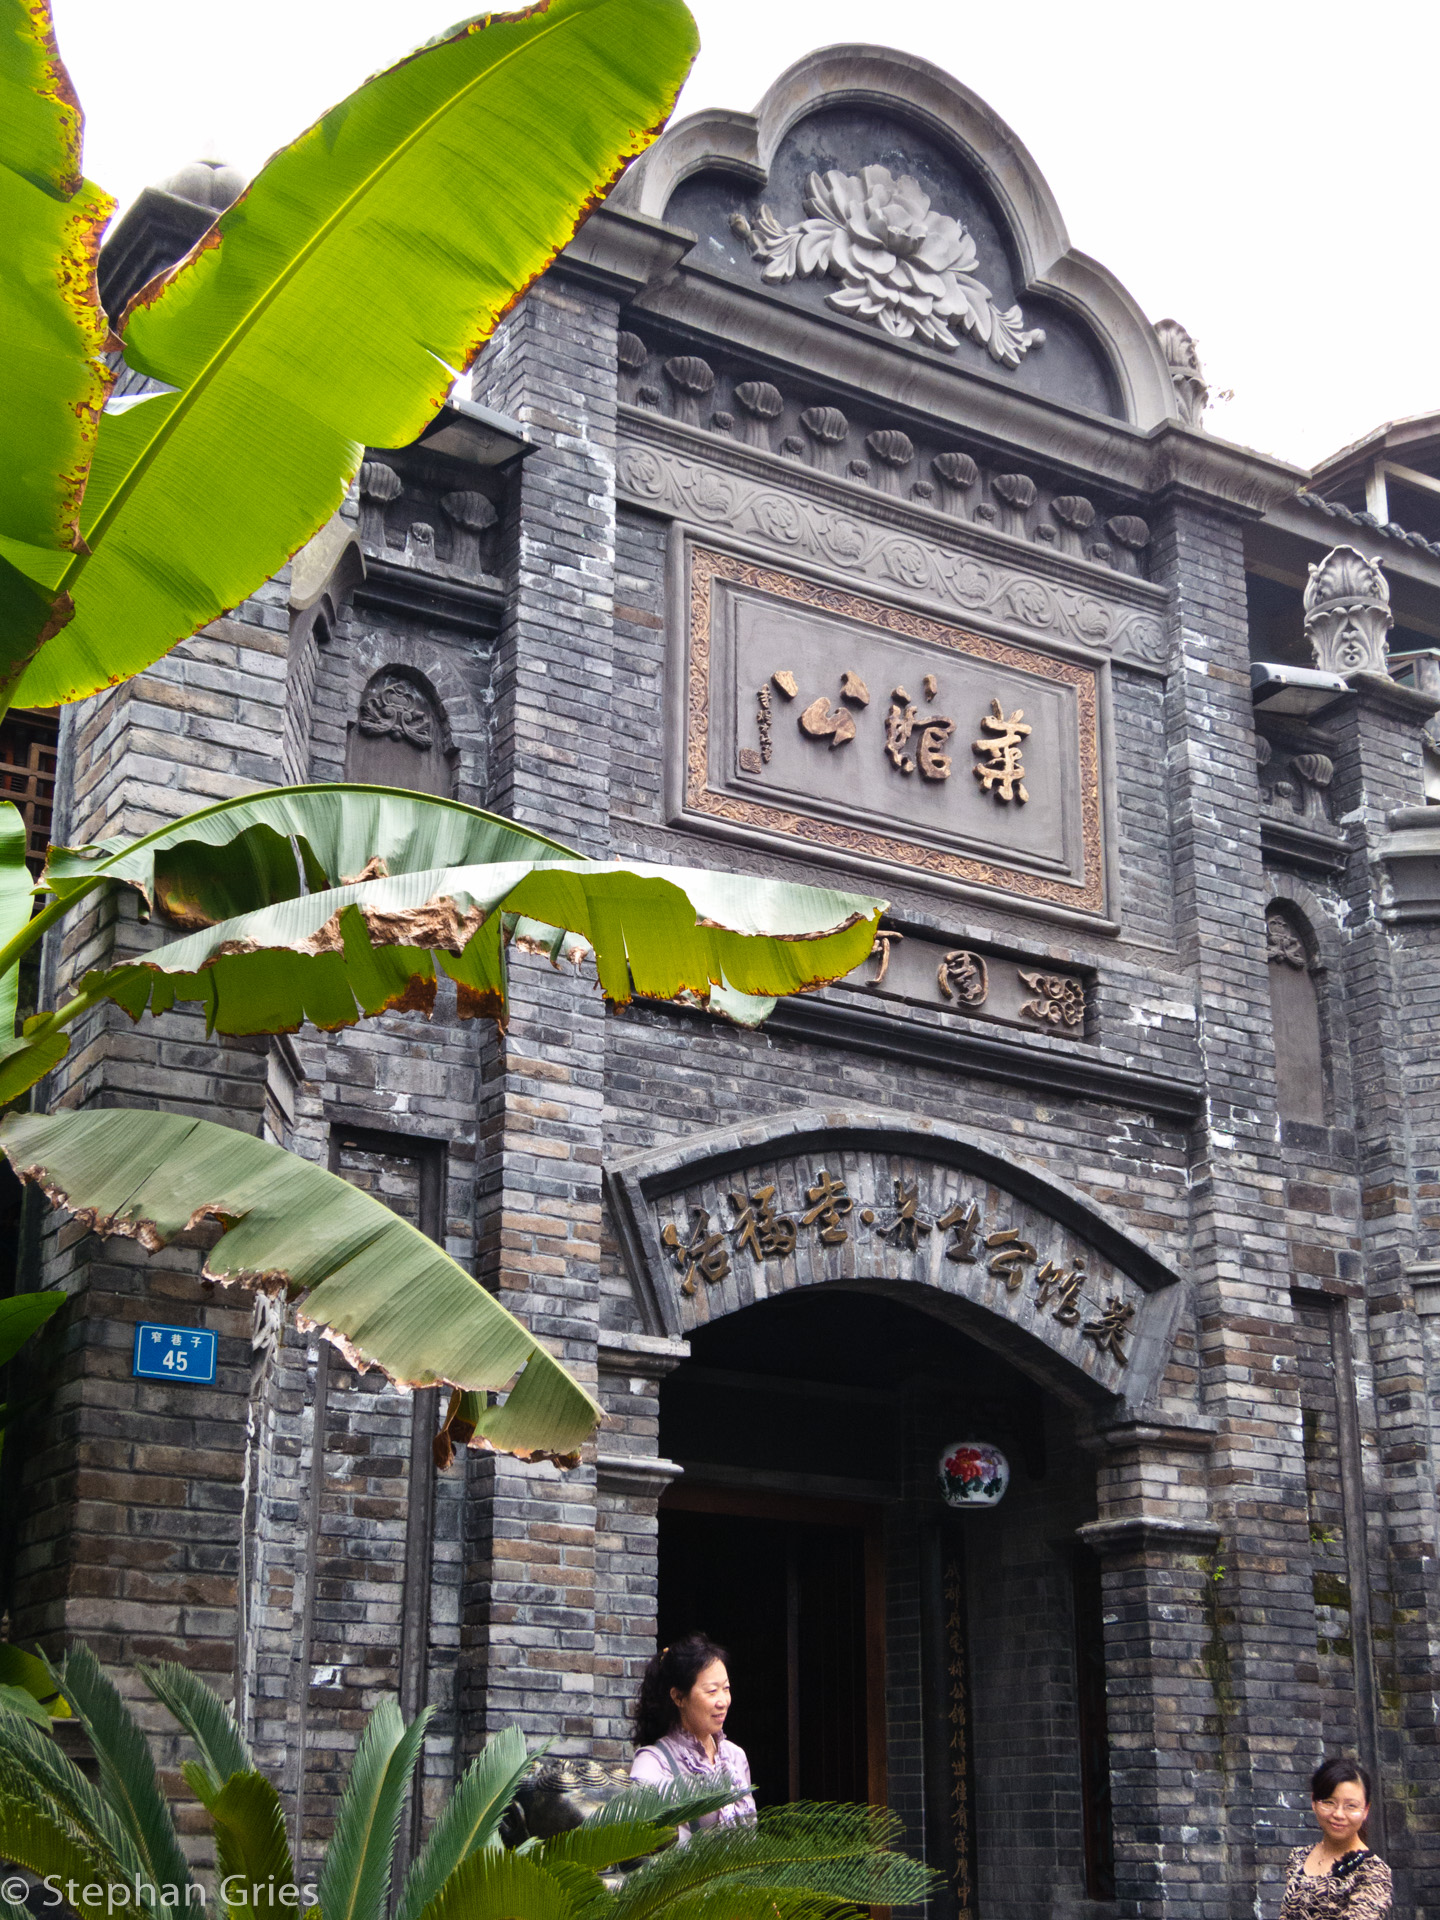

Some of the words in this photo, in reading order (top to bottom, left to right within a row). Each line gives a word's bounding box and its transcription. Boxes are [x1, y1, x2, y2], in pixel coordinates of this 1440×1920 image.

[150, 1331, 203, 1349] 窄巷子
[162, 1349, 188, 1372] 45
